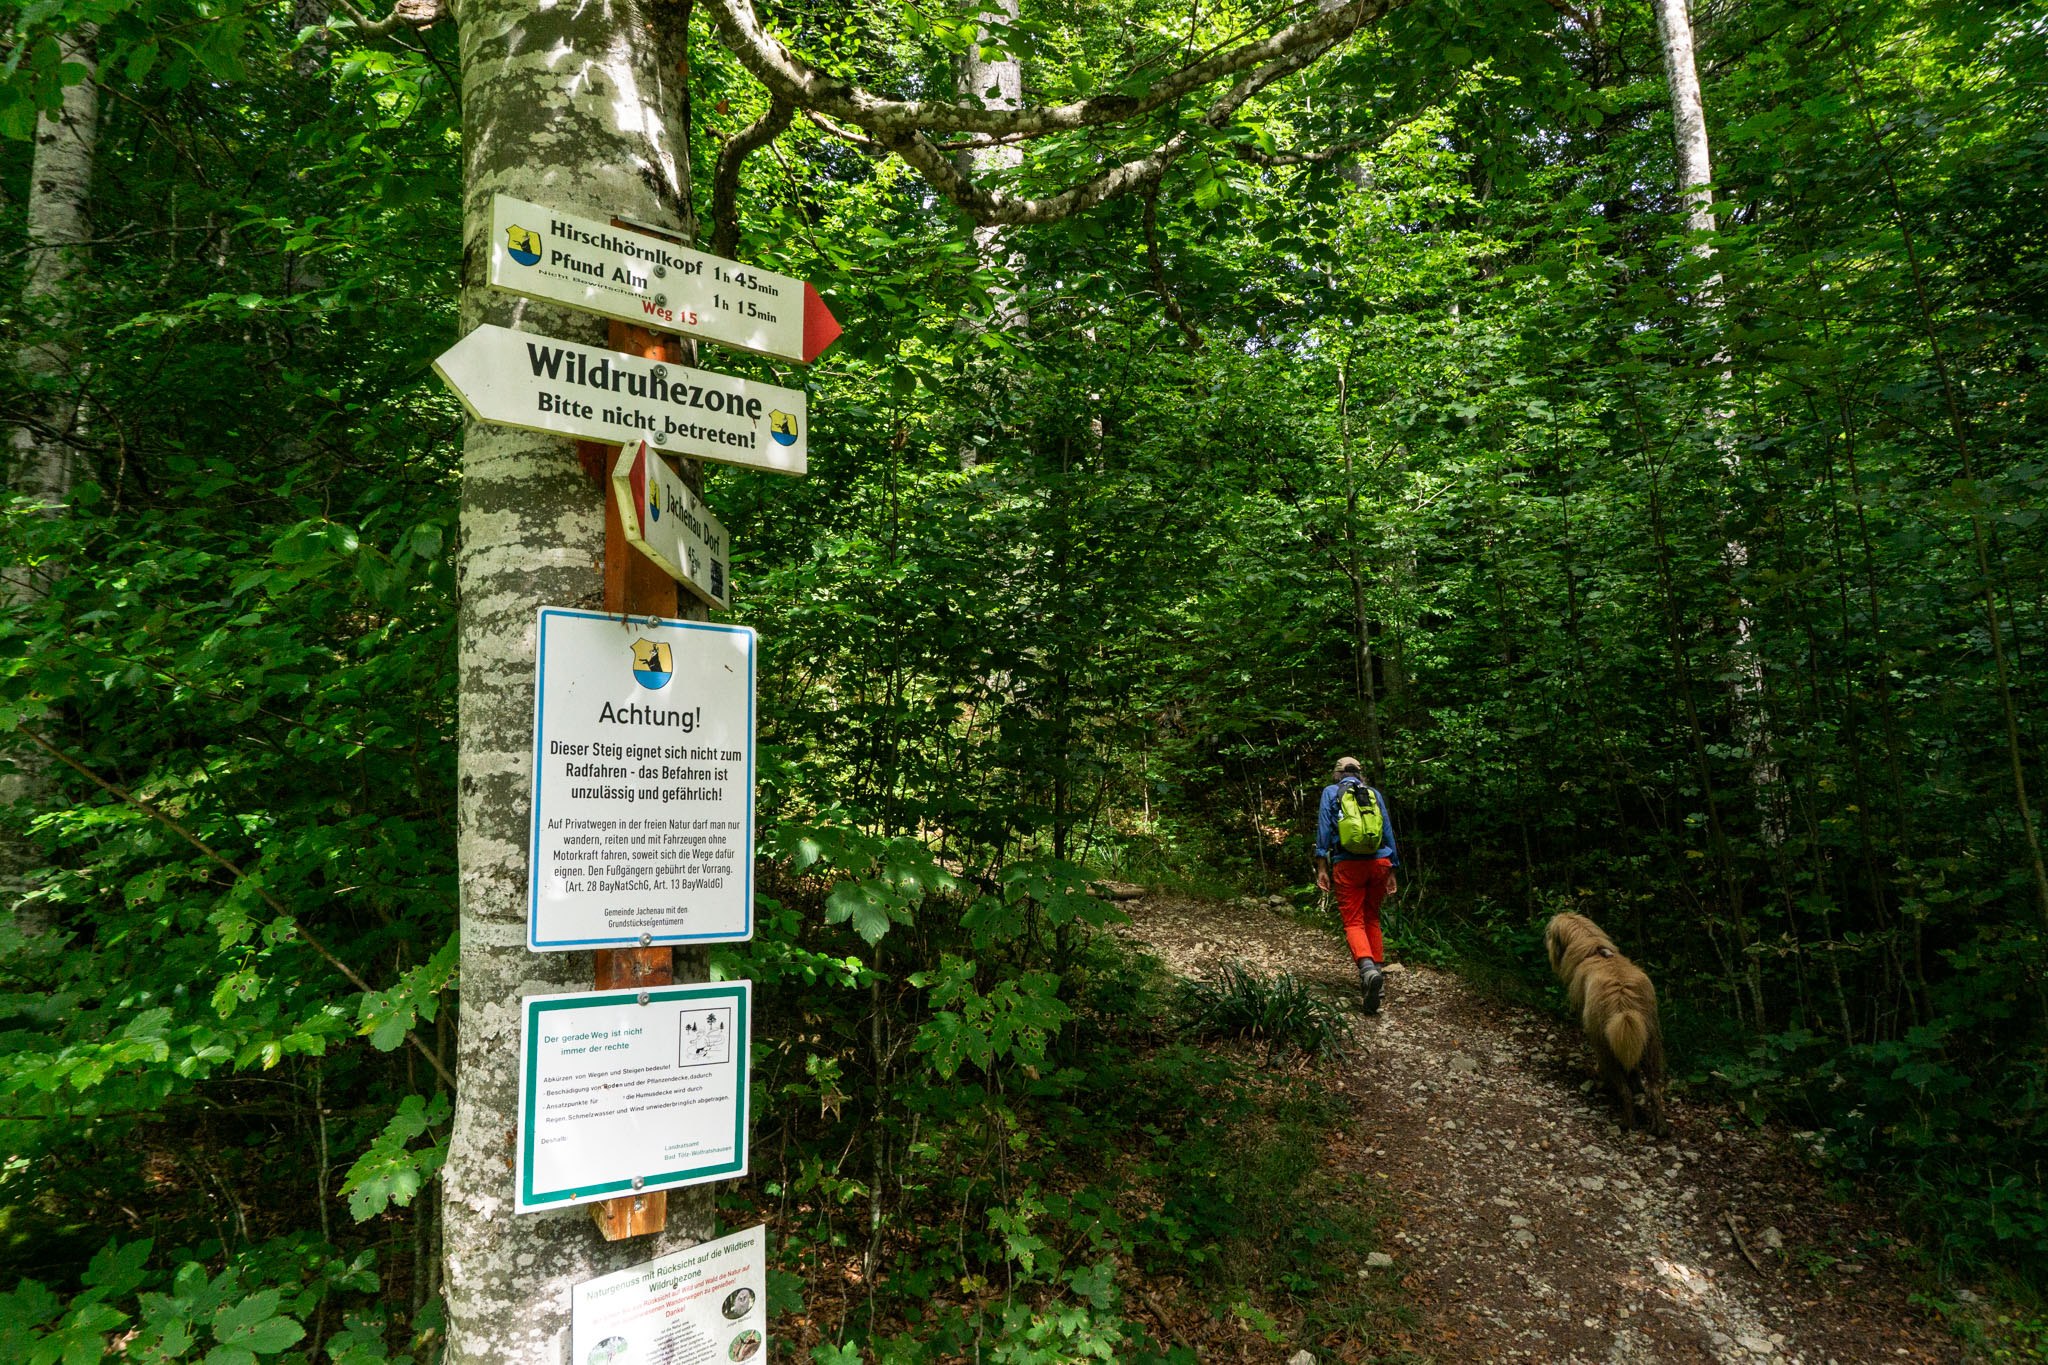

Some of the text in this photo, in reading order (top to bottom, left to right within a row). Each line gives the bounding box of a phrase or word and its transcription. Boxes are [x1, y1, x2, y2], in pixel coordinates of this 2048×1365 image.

[551, 220, 703, 276] Hirschhörnlkopf
[735, 267, 779, 297] 45min
[538, 269, 569, 280] Nicht
[551, 250, 605, 278] Pfund
[612, 267, 648, 290] Alm
[737, 300, 777, 323] 15min
[642, 300, 698, 326] Weg 15
[526, 343, 762, 420] Wildruhezone
[538, 391, 756, 449] Bitte nicht betreten!
[703, 521, 720, 557] Dorf
[599, 701, 701, 733] Achtung!
[550, 740, 742, 762] Dieser Steig eignet sich nicht zum
[566, 762, 627, 778] Radfahren
[638, 765, 659, 779] das
[662, 766, 711, 781] Befahren
[714, 768, 728, 781] ist
[571, 785, 722, 803] unzulässig und gefährlich!
[547, 818, 740, 832] Auf Privatwegen in der freien Natur darf man nur
[563, 834, 727, 847] wandern, reiten und mit Fahrzeugen ohne
[553, 848, 734, 862] Motorkraft fahren, soweit sich die Wege dafür
[554, 863, 733, 879] eignen. Den Fußgängern gebührt der Vorrang.
[587, 881, 597, 892] 28
[599, 880, 651, 894] BayNatSchG,
[653, 879, 668, 890] Art.
[671, 879, 680, 890] 13
[682, 878, 723, 890] BayWaldG)
[604, 906, 688, 917] Gemeinde Jachenau mit den
[608, 917, 684, 928] Grundstückseigentümern
[544, 1027, 643, 1046] Der gerade Weg ist nicht
[561, 1041, 630, 1056] immer der rechte
[587, 1070, 609, 1079] Wegen
[609, 1069, 622, 1077] und
[586, 1238, 755, 1301] Naturgenuss mit Rücksicht auf die Wildtiere
